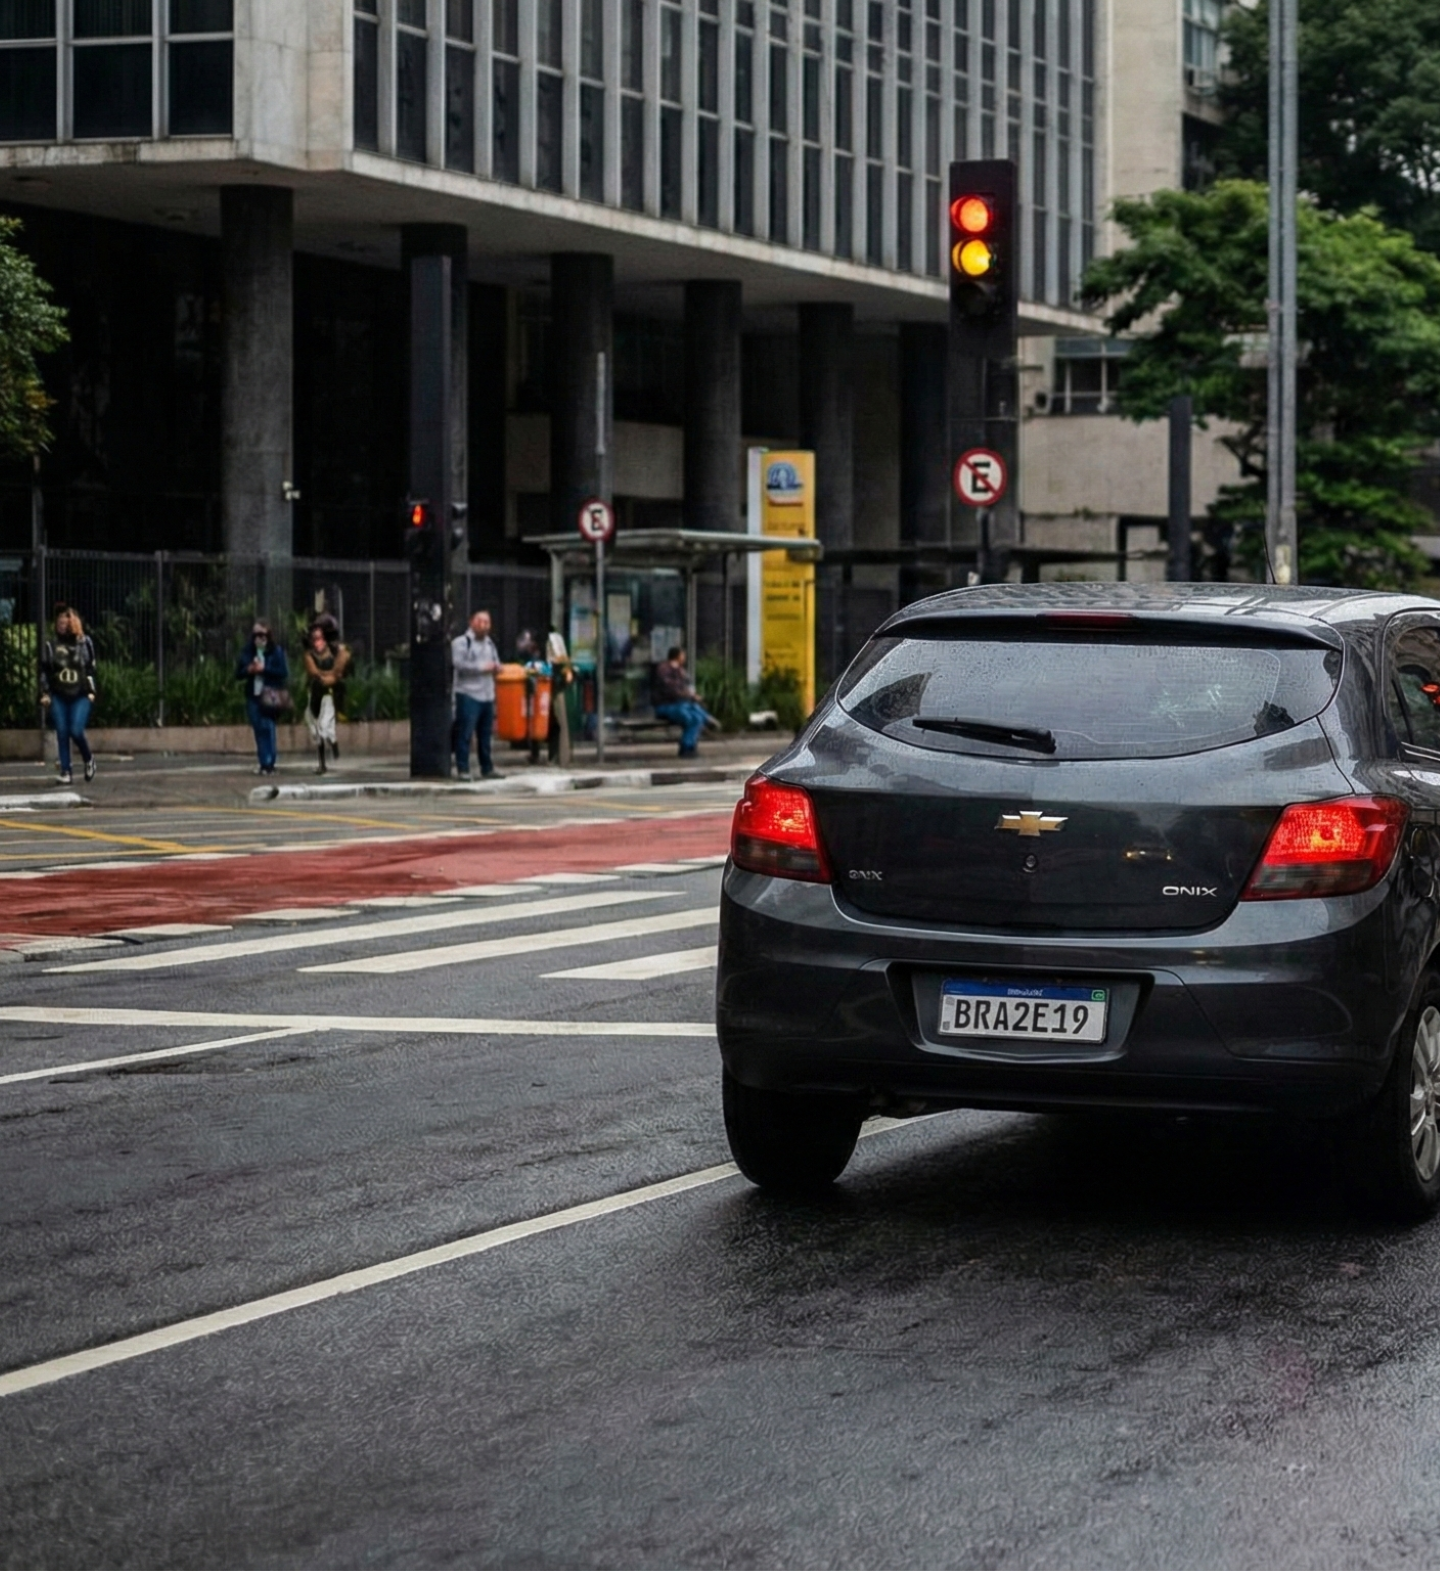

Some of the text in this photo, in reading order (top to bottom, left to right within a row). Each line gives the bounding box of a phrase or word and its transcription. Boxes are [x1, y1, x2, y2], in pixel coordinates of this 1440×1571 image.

[971, 461, 991, 493] E
[1162, 885, 1218, 897] ONIX
[953, 998, 1089, 1035] BRA2E19
